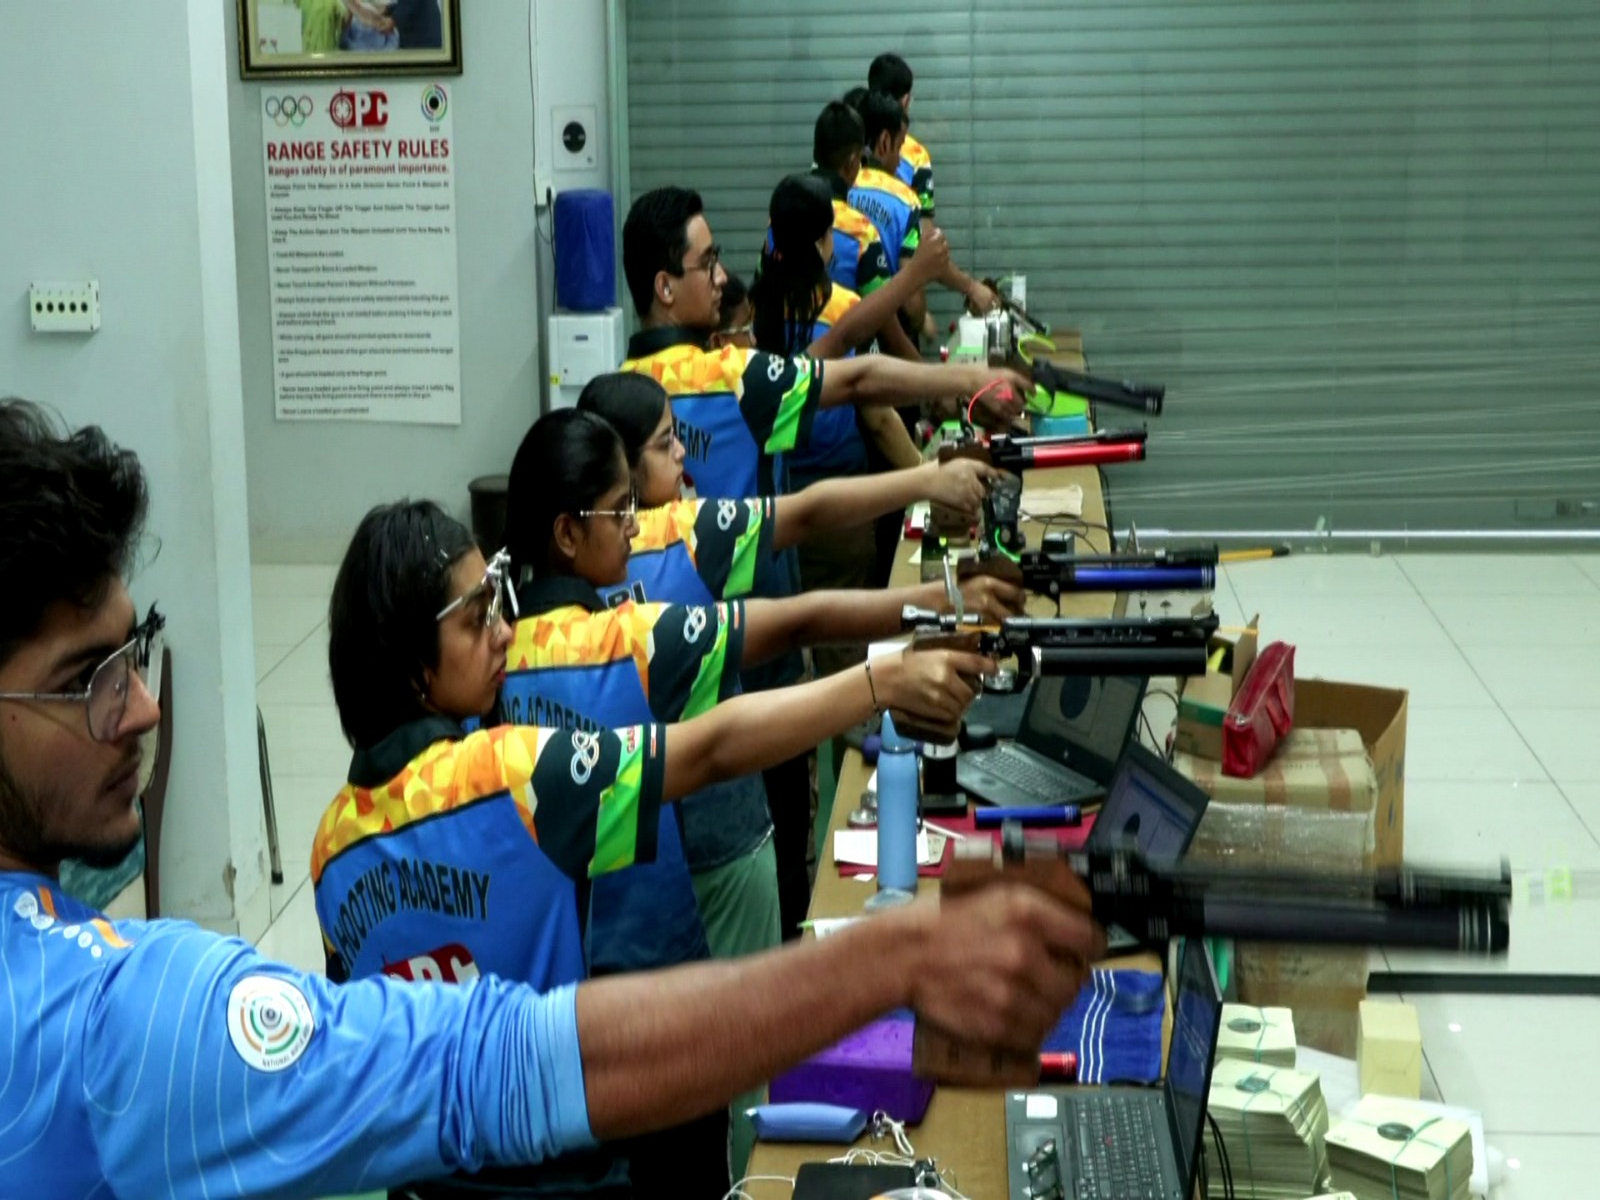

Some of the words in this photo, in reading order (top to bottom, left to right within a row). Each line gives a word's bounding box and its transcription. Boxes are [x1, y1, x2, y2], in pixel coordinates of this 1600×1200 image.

[267, 141, 326, 161] RANGE
[330, 139, 393, 160] SAFETY
[398, 138, 449, 158] RULES
[268, 165, 300, 178] Ranges
[301, 164, 327, 177] safety
[329, 164, 337, 175] is
[338, 163, 348, 175] of
[350, 163, 396, 176] paramount
[398, 162, 449, 175] importance.
[399, 857, 490, 921] ACADEMY
